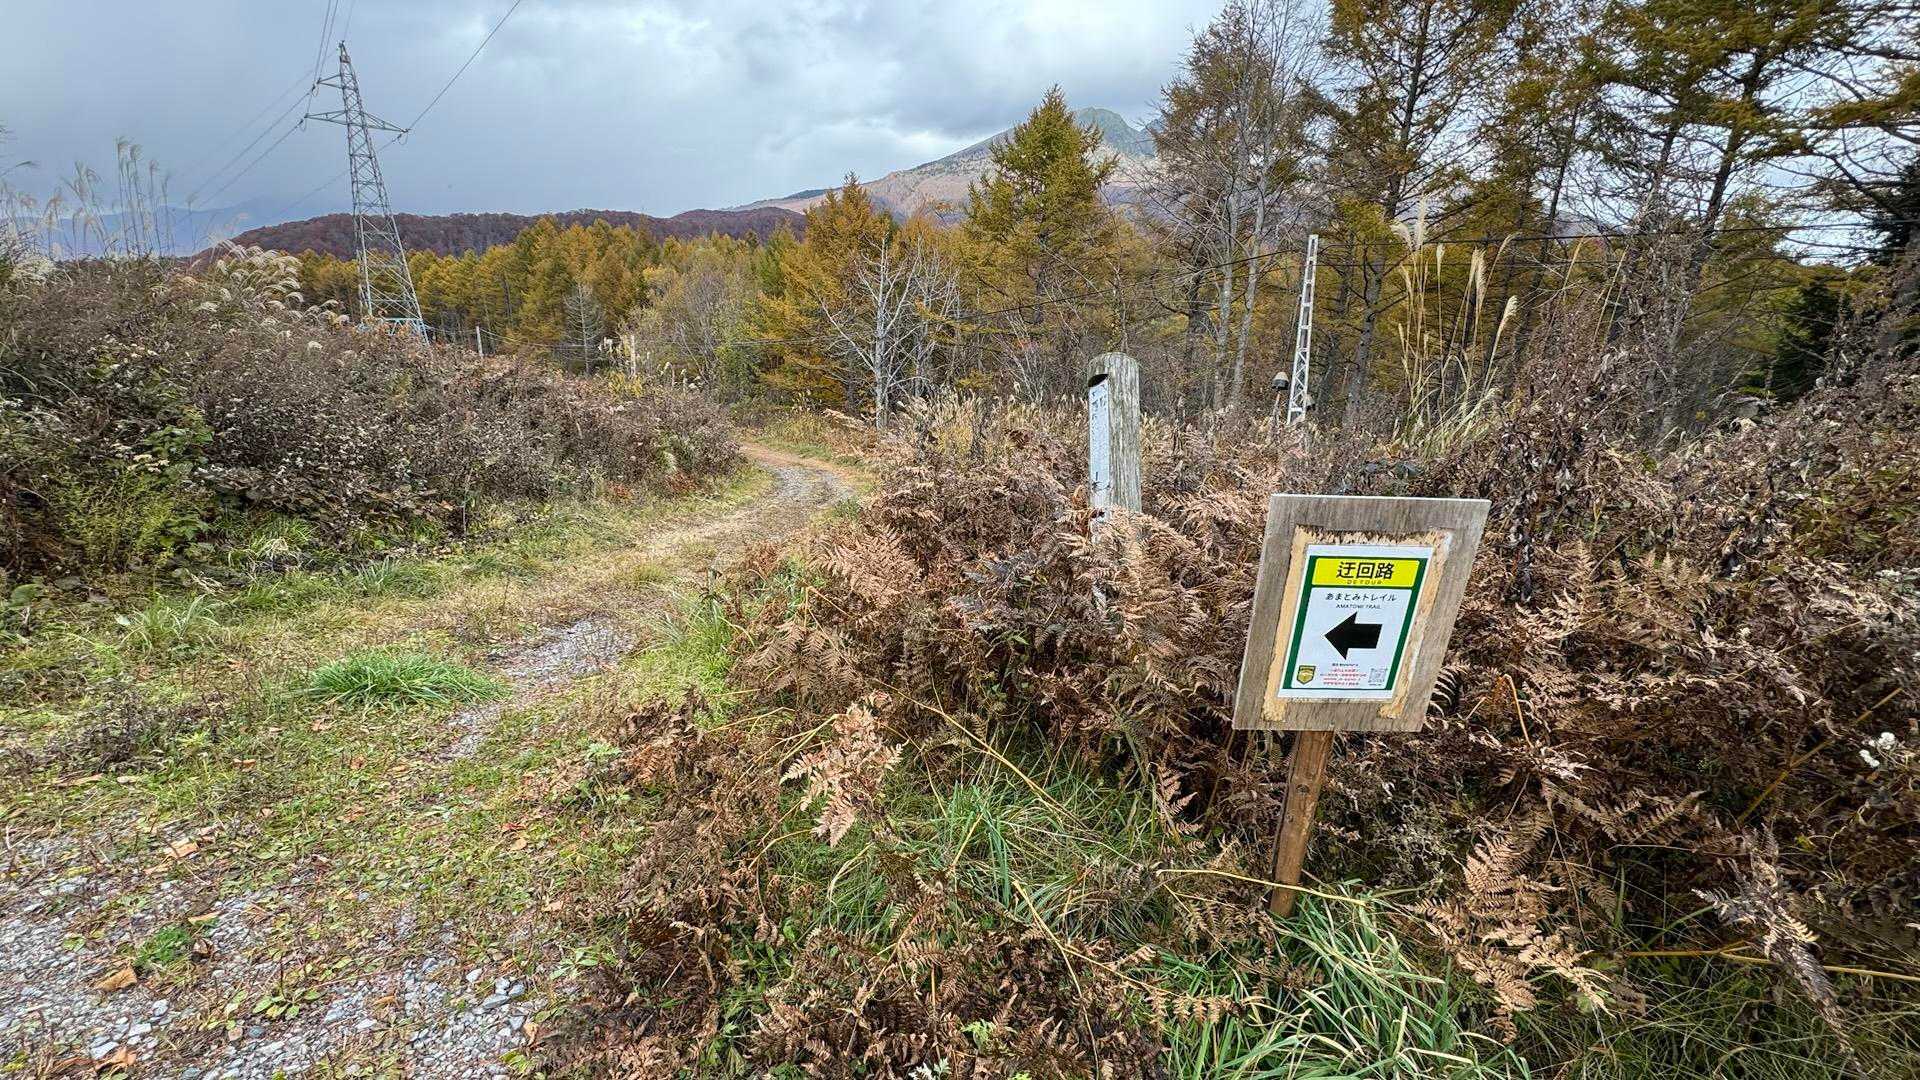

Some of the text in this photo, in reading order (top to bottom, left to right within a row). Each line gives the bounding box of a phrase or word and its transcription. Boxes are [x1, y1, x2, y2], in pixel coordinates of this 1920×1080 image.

[1336, 562, 1394, 579] 迂回路
[1325, 593, 1397, 601] あまとみトレイル
